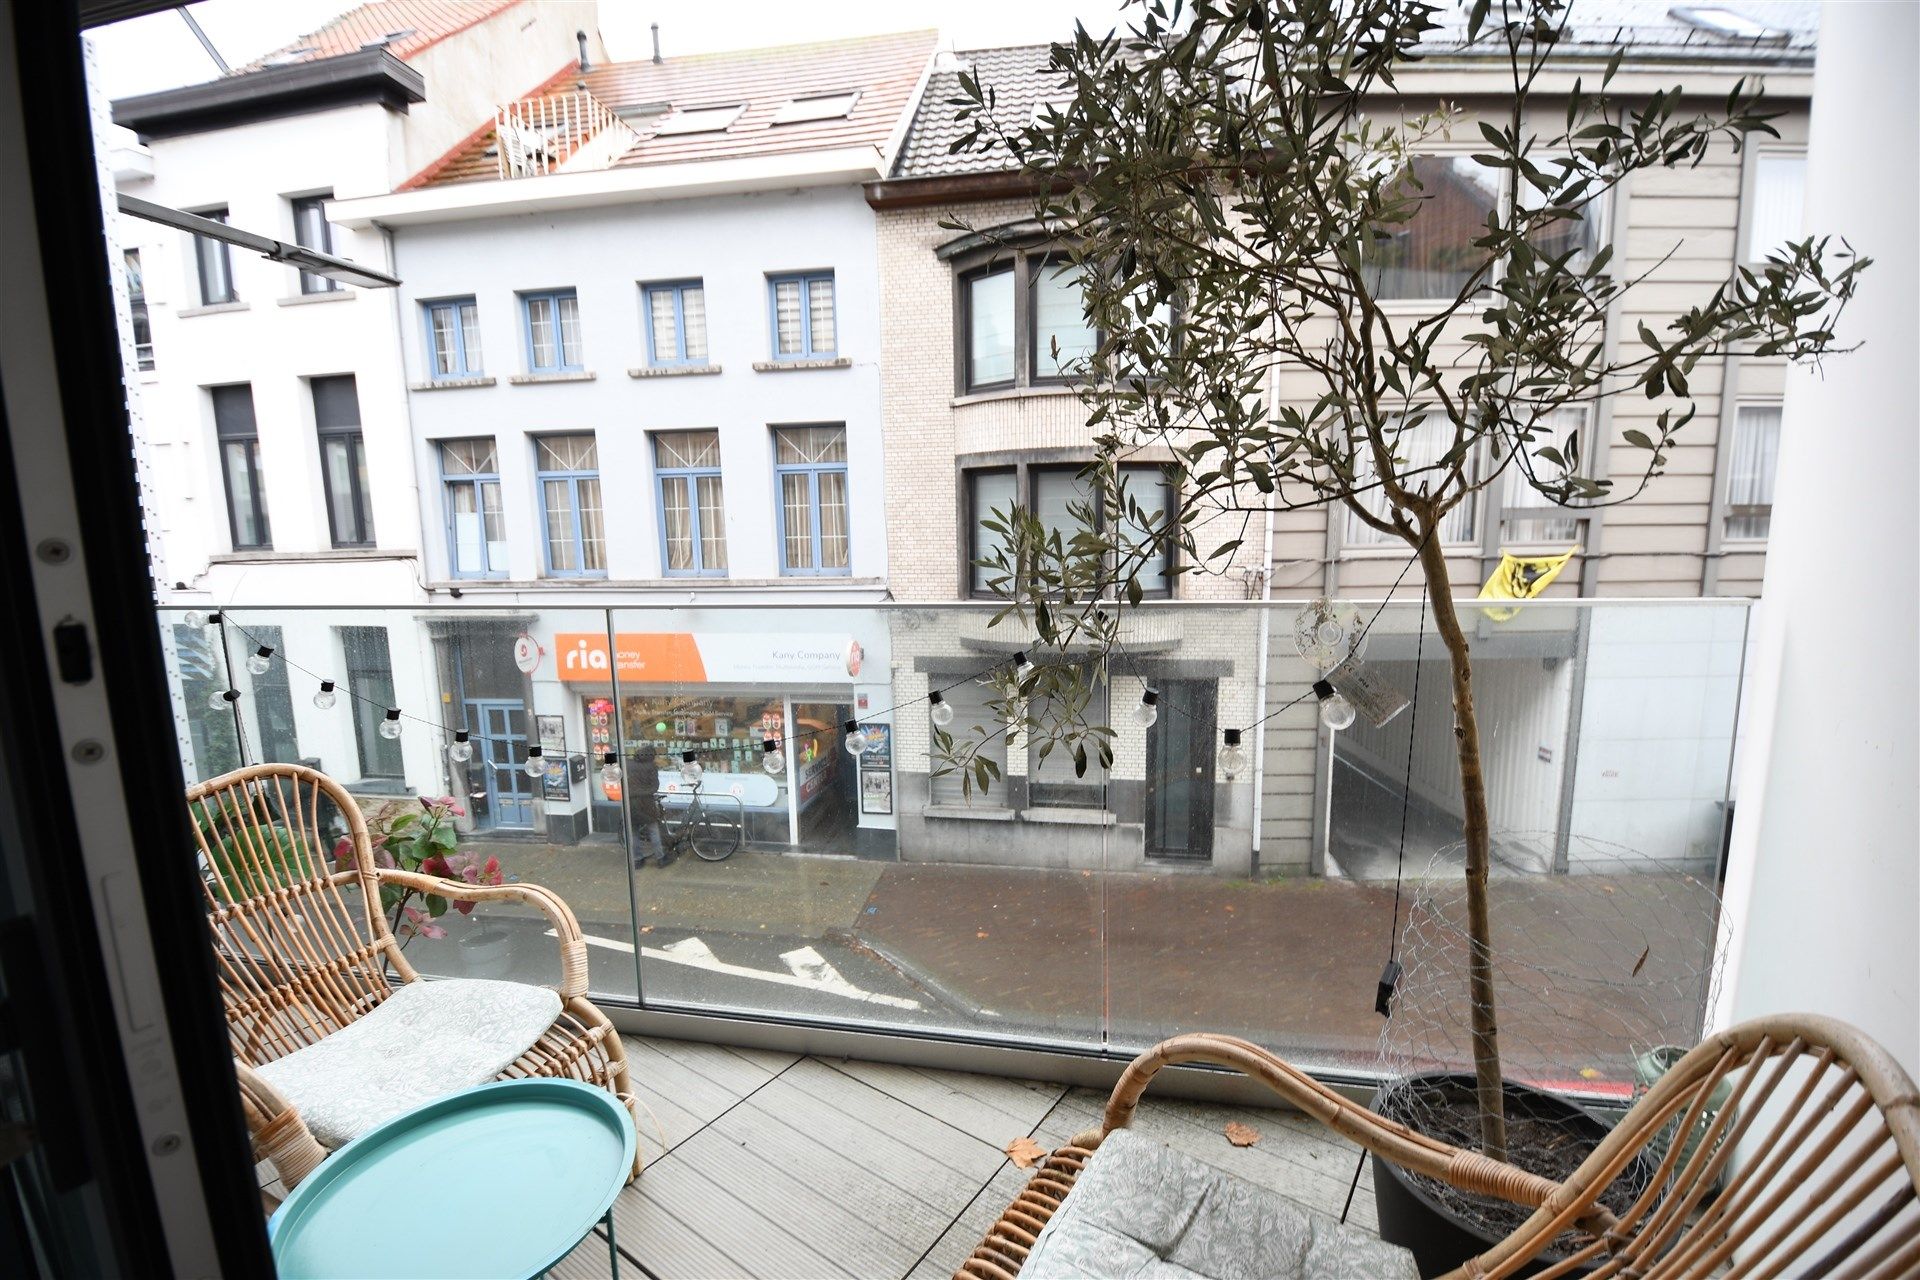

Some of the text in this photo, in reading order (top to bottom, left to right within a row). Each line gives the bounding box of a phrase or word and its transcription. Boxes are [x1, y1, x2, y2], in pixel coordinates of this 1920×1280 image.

[566, 639, 608, 669] ria
[616, 650, 641, 661] oney
[772, 650, 841, 661] Kany Company
